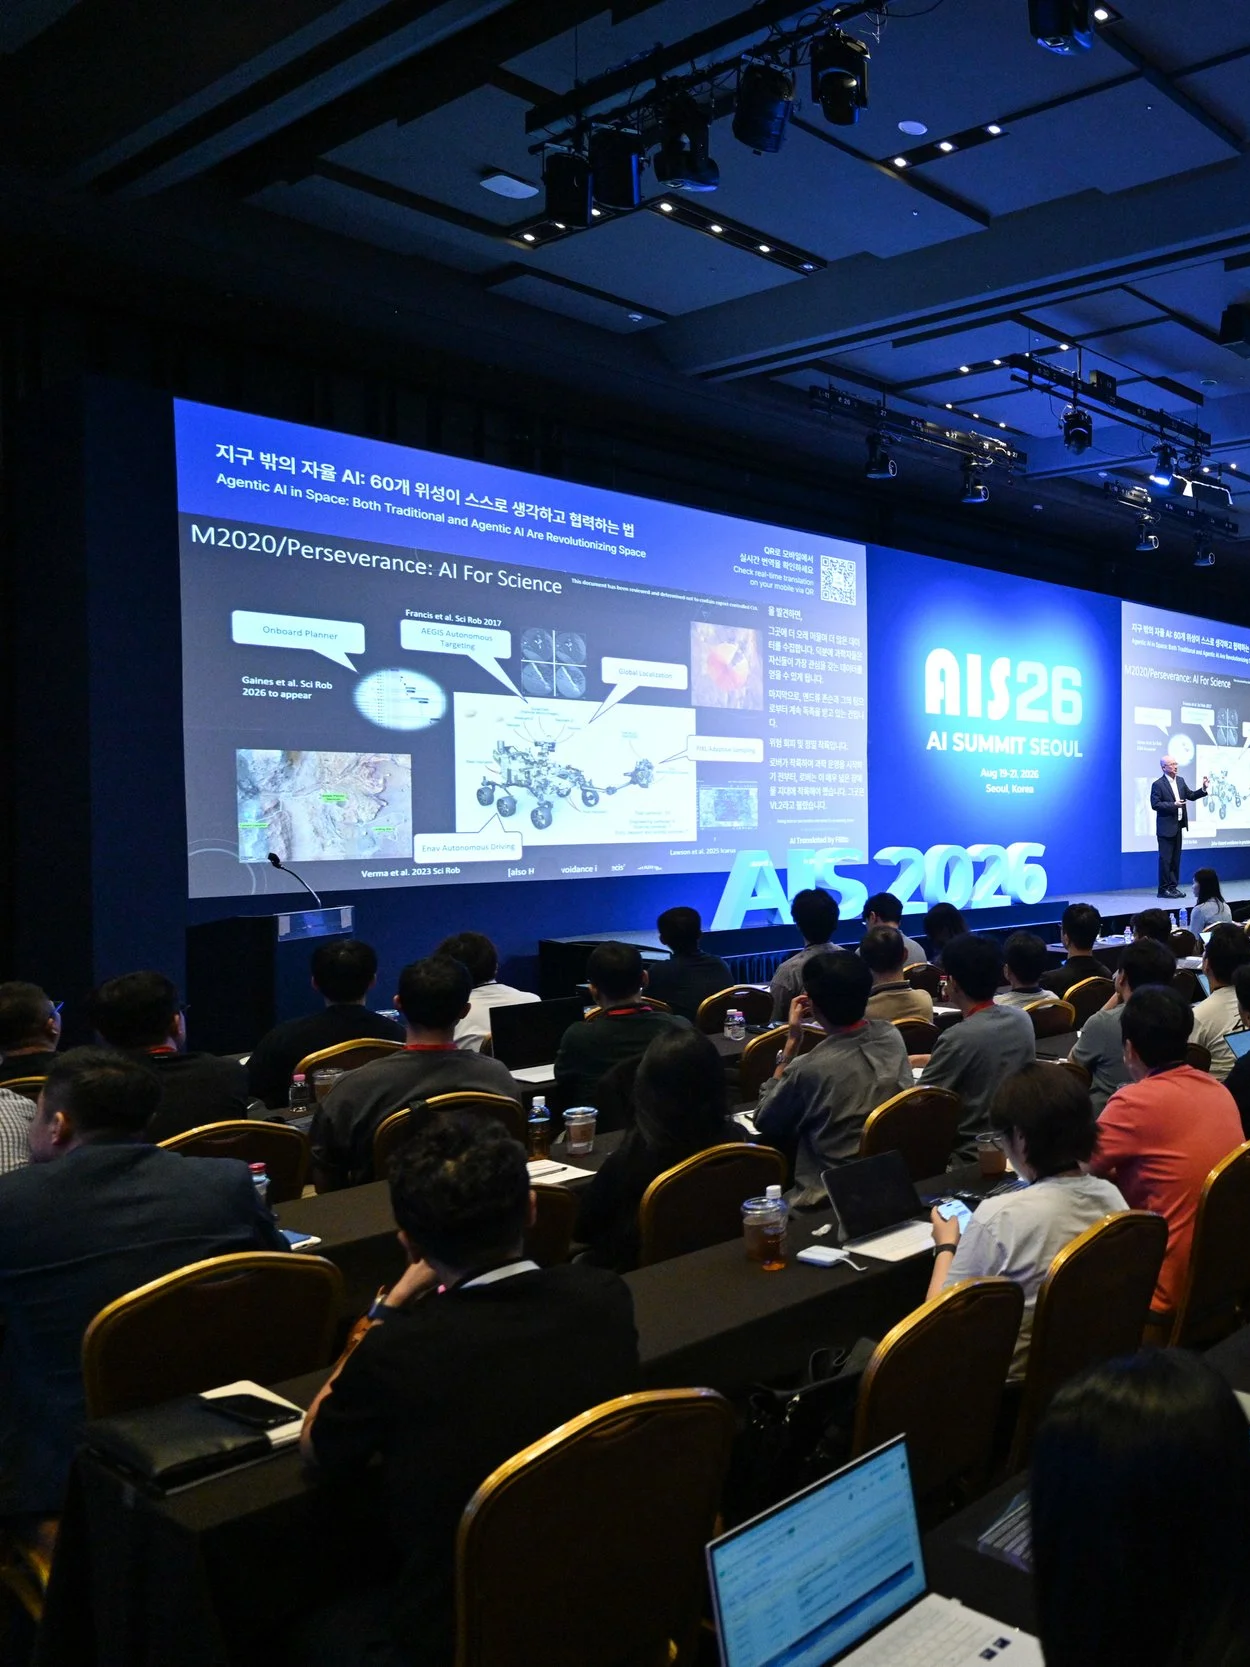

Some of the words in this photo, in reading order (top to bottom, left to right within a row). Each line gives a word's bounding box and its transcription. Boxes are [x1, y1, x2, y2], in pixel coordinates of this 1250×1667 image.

[215, 443, 254, 466] 지구
[260, 452, 296, 474] 밖의
[301, 460, 336, 482] 자율
[342, 469, 365, 485] AI:
[370, 474, 410, 496] 60개
[415, 482, 460, 506] 위성이
[464, 492, 508, 513] 스스로
[512, 501, 566, 524] 생각하고
[570, 512, 620, 536] 협력하는
[622, 523, 635, 538] 법
[216, 473, 270, 492] Agentic
[274, 483, 287, 496] AI
[290, 486, 302, 498] in
[306, 488, 350, 506] Space:
[352, 496, 382, 512] Both
[384, 502, 444, 523] Traditional
[448, 512, 468, 527] and
[471, 518, 512, 536] Agentic
[514, 526, 524, 536] AI
[527, 528, 544, 541] Are
[546, 532, 616, 555] Revolutionizing
[618, 545, 646, 559] Space
[191, 524, 433, 576] M2020/Perseverance:
[438, 561, 457, 579] AI
[464, 564, 493, 584] For
[498, 570, 562, 594] Science
[764, 546, 781, 556] QR로
[782, 549, 814, 564] 모바일에서
[740, 553, 760, 565] 실시간
[761, 556, 780, 569] 번역을
[782, 560, 814, 574] 확인하세요
[733, 566, 754, 576] Check
[754, 569, 782, 580] real-time
[783, 574, 814, 586] translation
[759, 580, 773, 588] your
[774, 583, 794, 593] mobile
[405, 609, 433, 619] Francis
[468, 616, 482, 624] Rob
[484, 618, 502, 626] 2017
[262, 626, 302, 637] Onboard
[305, 630, 338, 640] Planner
[421, 628, 444, 636] AEGIS
[446, 630, 493, 642] Autonomous
[440, 640, 476, 651] Targeting
[618, 668, 638, 676] Global
[1124, 664, 1192, 682] M2020/Perseverance:
[1192, 674, 1199, 684] AI
[1200, 676, 1210, 686] For
[1210, 676, 1231, 688] Science
[242, 676, 274, 686] Gaines
[288, 679, 298, 688] al.
[300, 680, 312, 688] Sci
[315, 681, 332, 690] Rob
[924, 648, 1082, 726] AIS26
[242, 688, 266, 697] 2026
[280, 692, 312, 701] appear
[769, 718, 778, 728] 다.
[926, 731, 947, 750] AI
[952, 733, 1026, 756] SUMMIT
[1030, 738, 1083, 758] SEOUL
[980, 768, 997, 780] Aug
[1020, 770, 1040, 779] 2026
[986, 784, 1010, 794] Seoul,
[1012, 784, 1034, 794] Korea
[422, 844, 440, 852] Enav
[442, 844, 488, 852] Autonomous
[490, 843, 516, 852] Driving
[361, 870, 388, 878] Verma
[412, 868, 431, 876] 2023
[508, 868, 526, 878] [also
[710, 848, 869, 931] AIS
[874, 842, 1047, 914] 2026
